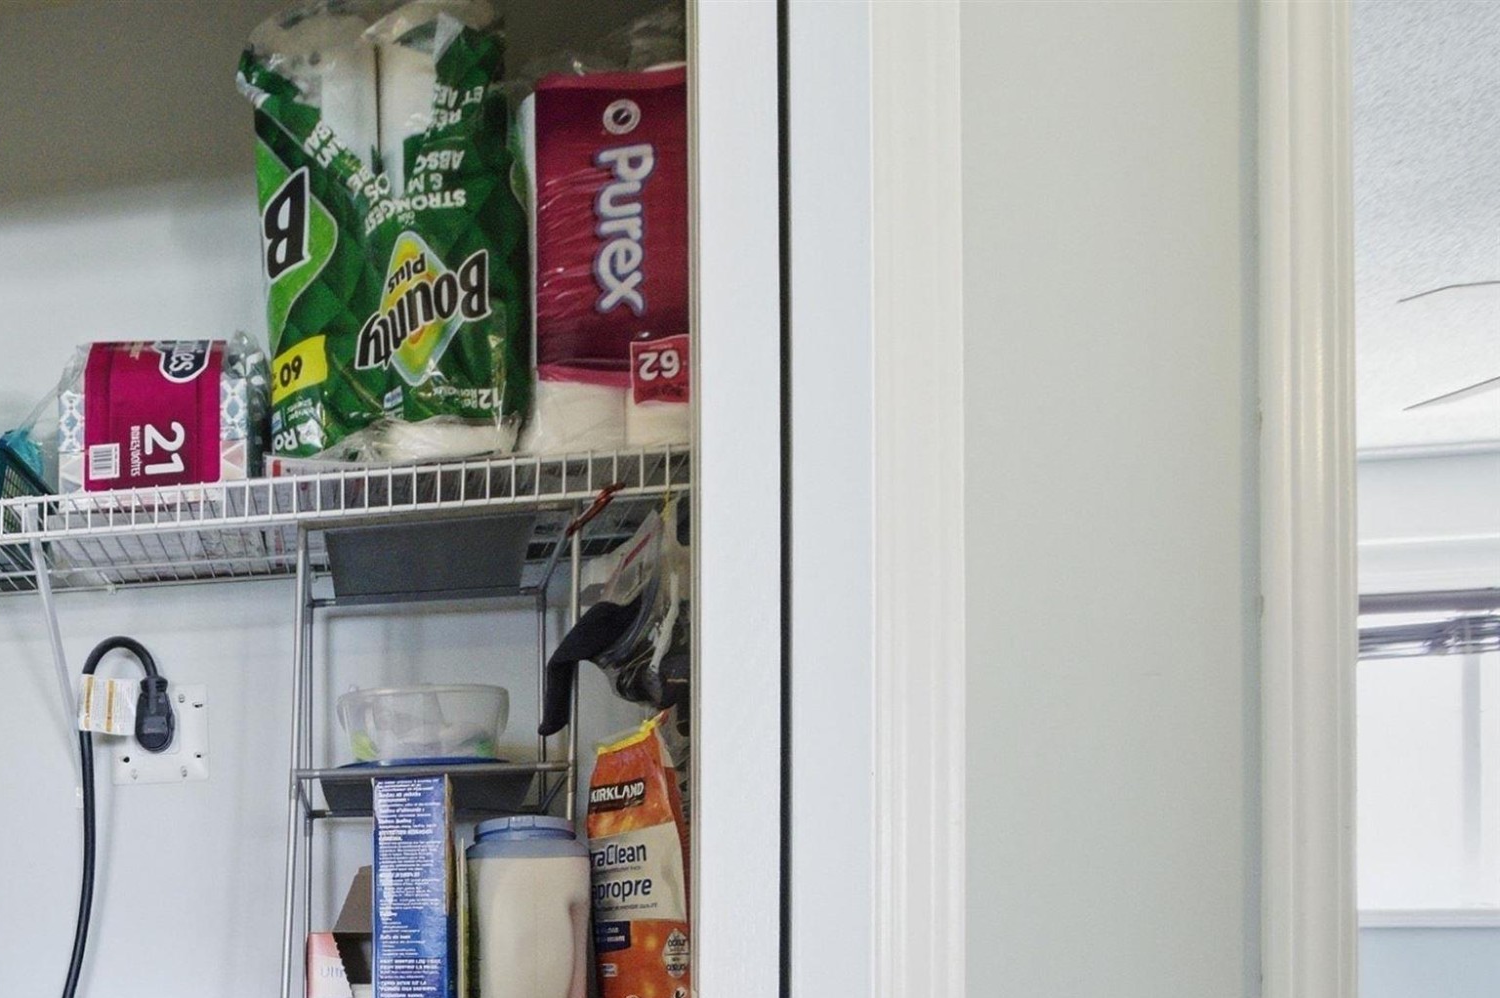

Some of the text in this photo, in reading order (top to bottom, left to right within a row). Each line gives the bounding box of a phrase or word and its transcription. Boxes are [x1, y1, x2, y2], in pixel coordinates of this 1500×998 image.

[364, 188, 466, 237] STRONGEST
[599, 144, 654, 312] Purex
[357, 251, 489, 368] Bounty
[280, 355, 303, 388] 60
[637, 349, 680, 382] 62
[143, 421, 186, 476] 21
[591, 781, 645, 803] KIRKLAND
